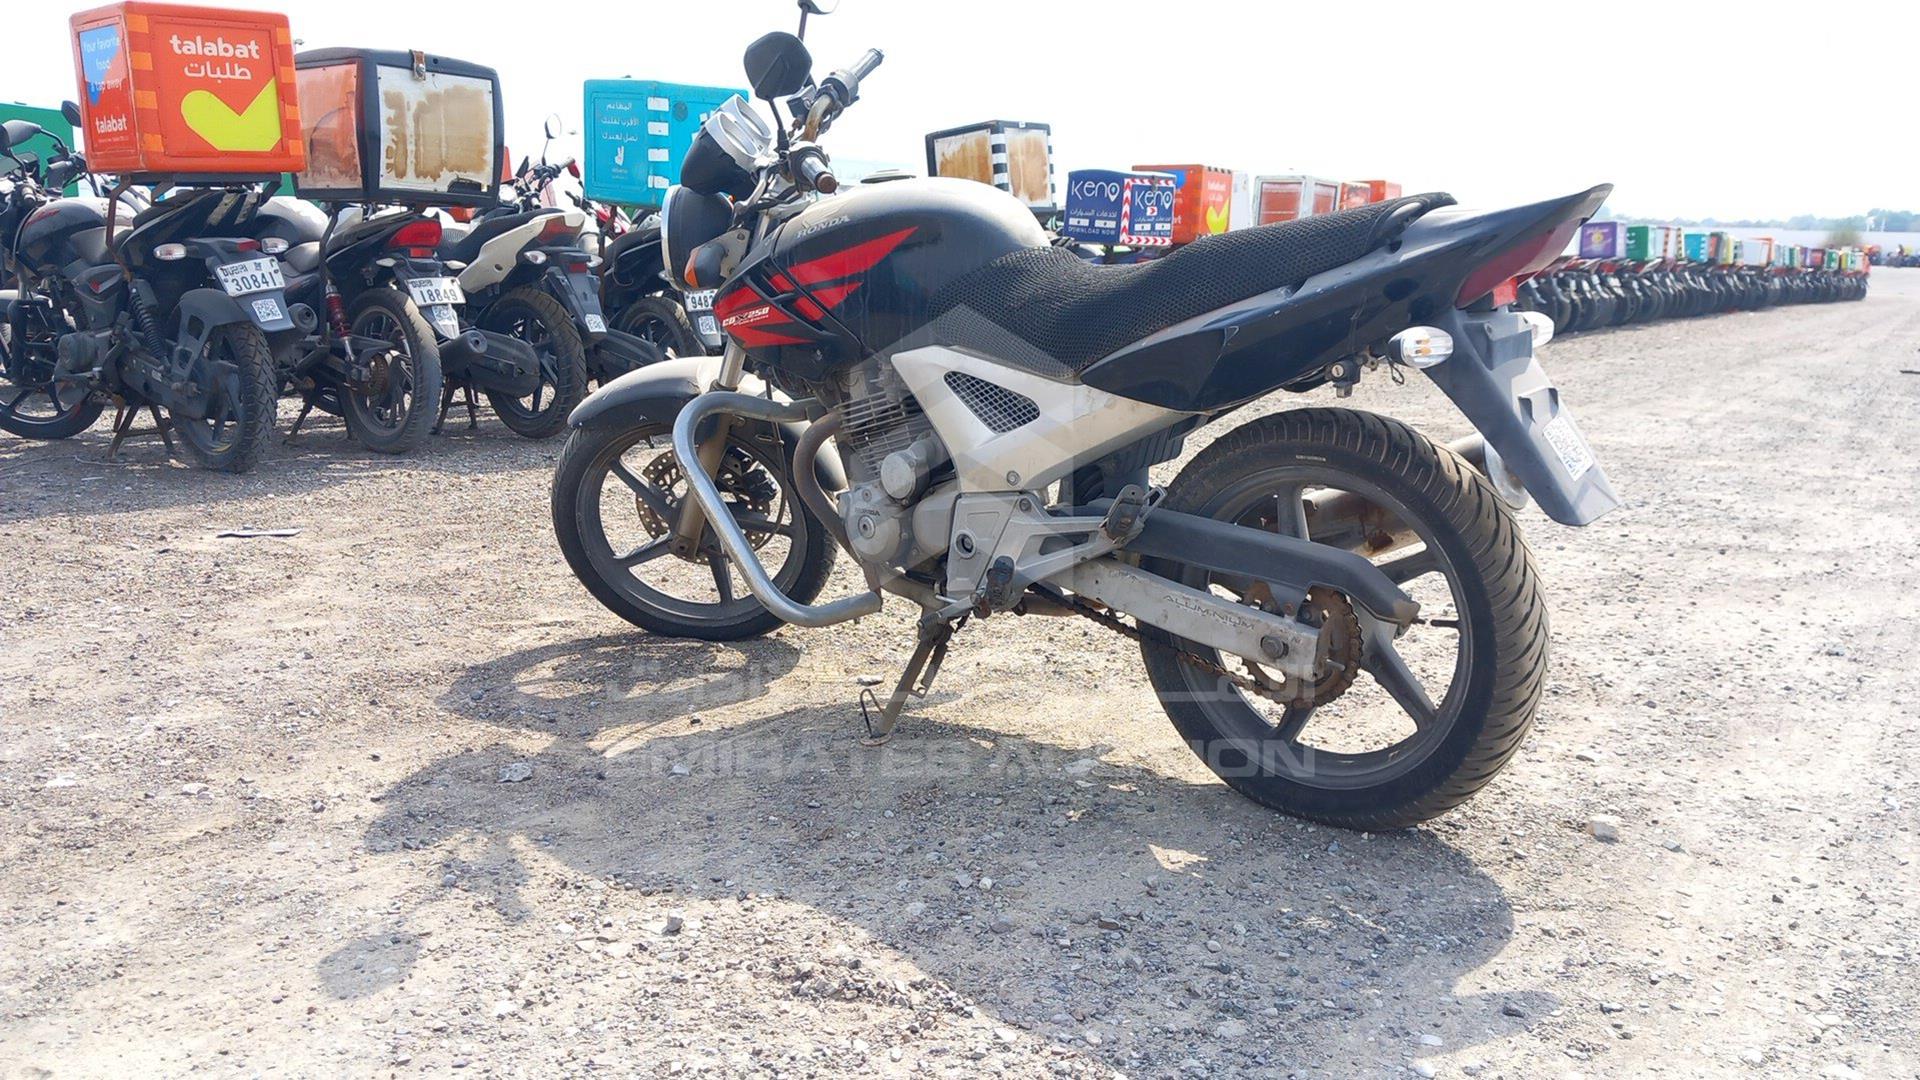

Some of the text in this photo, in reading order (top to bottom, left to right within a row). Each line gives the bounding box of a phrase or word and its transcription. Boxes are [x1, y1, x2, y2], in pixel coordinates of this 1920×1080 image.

[169, 34, 260, 59] talabat
[184, 61, 252, 83] طلبات
[95, 114, 128, 134] talabat
[231, 271, 277, 292] 30841
[420, 289, 458, 303] 18849
